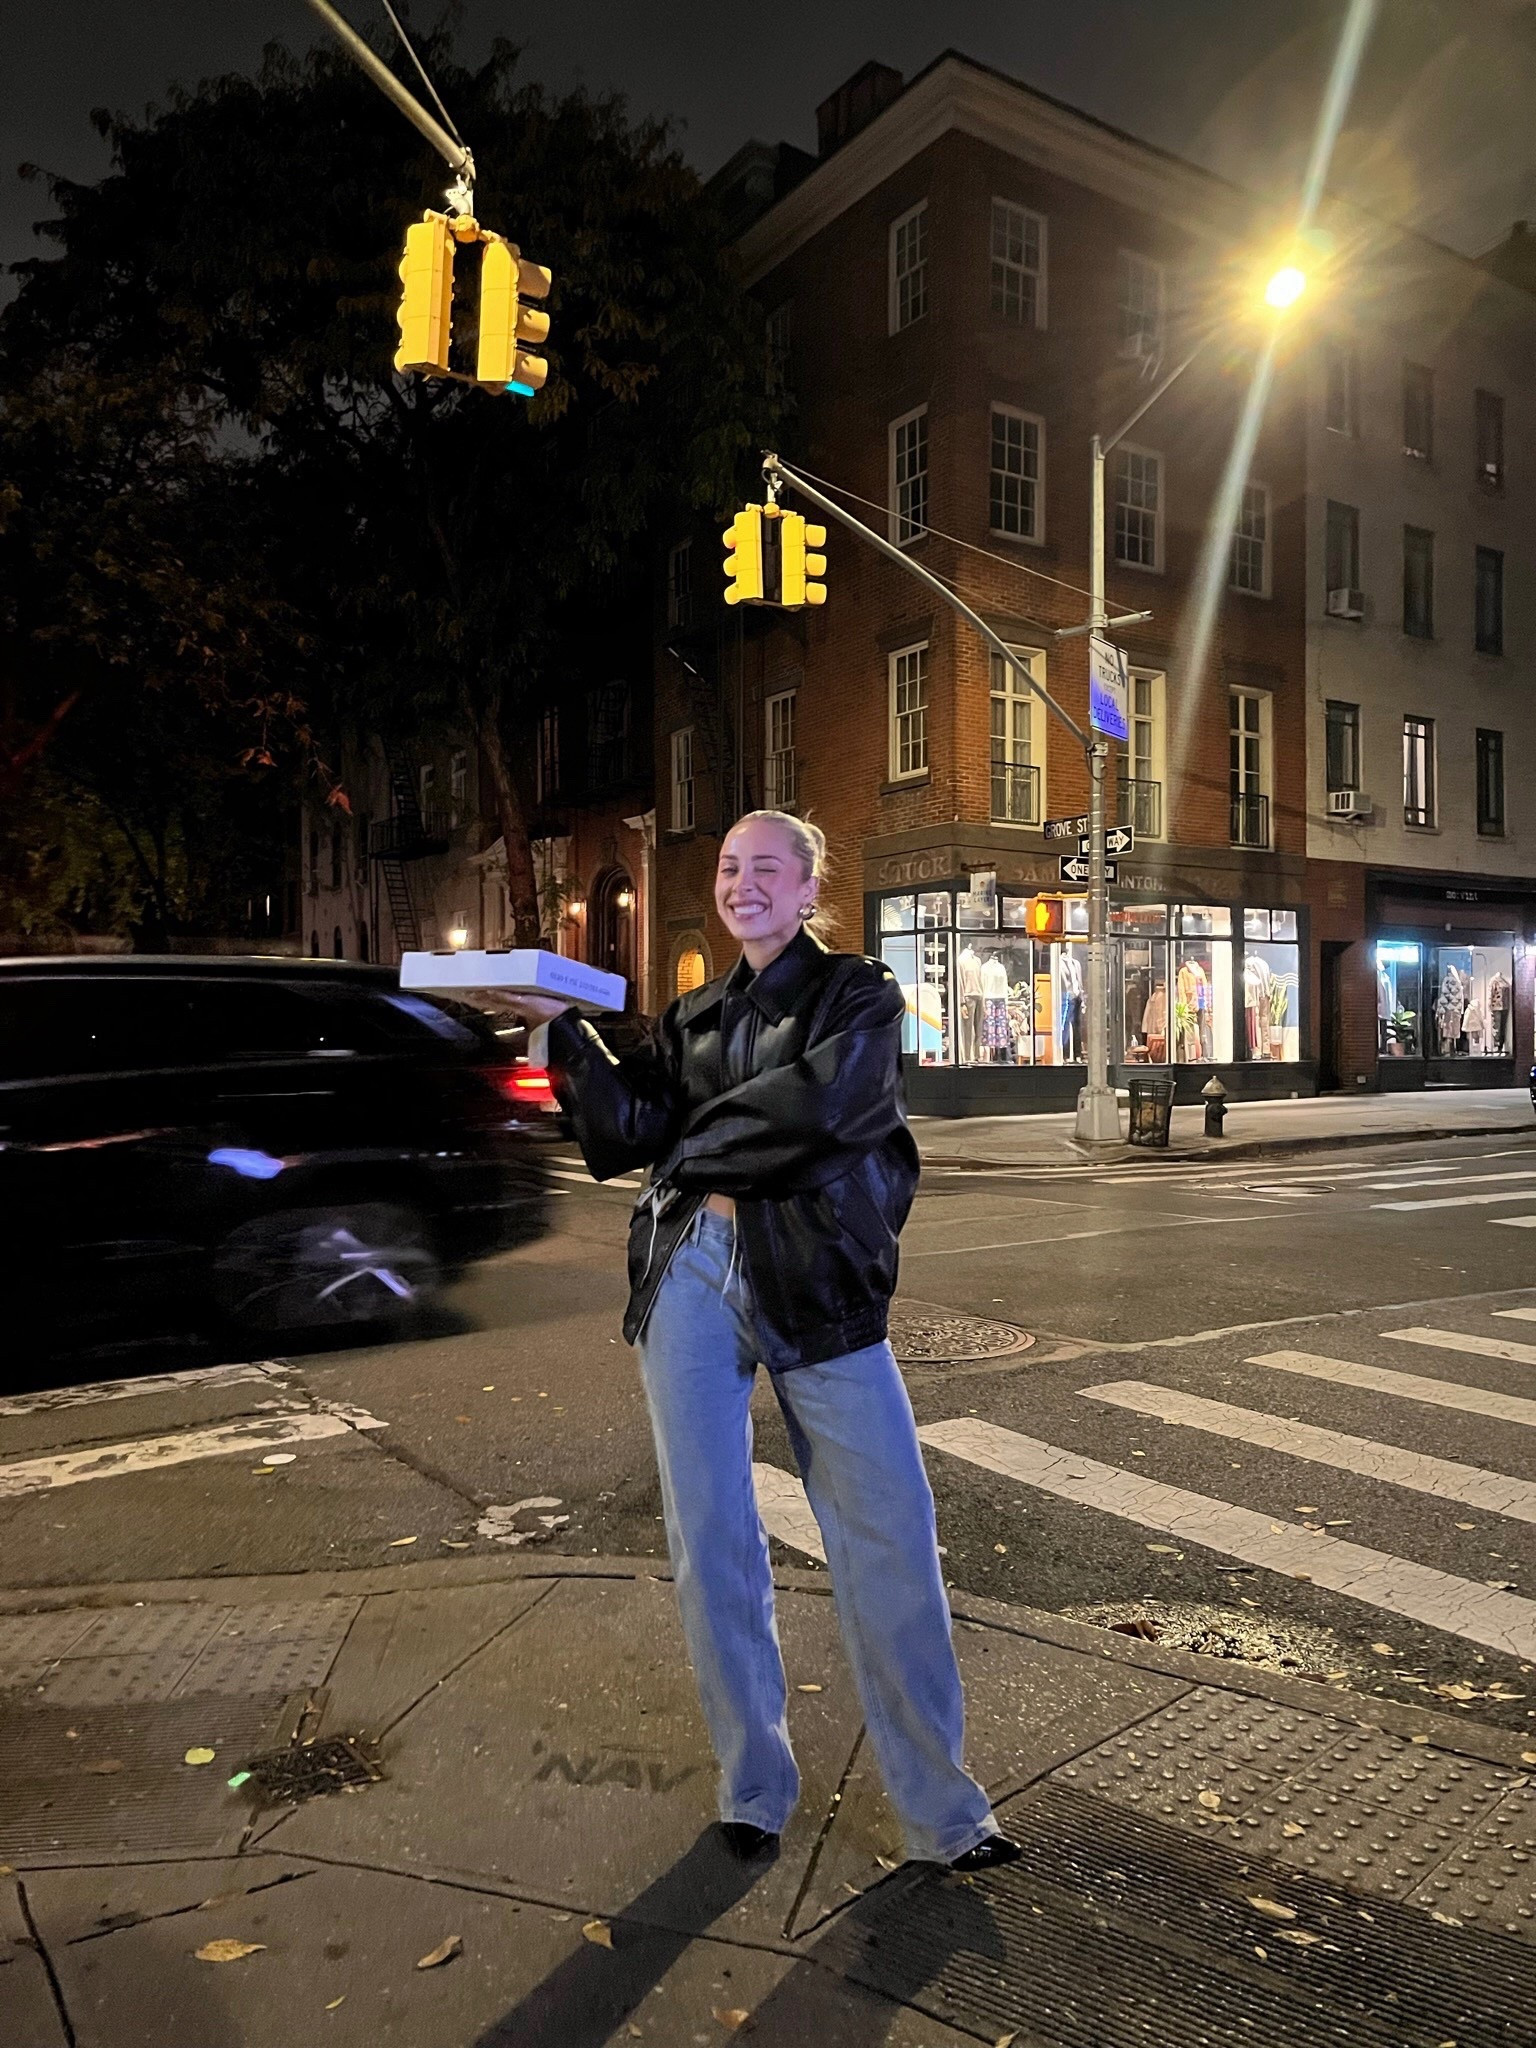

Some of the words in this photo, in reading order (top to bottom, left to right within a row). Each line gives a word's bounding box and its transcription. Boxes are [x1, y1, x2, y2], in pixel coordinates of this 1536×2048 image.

[1104, 652, 1114, 667] NO
[1098, 665, 1120, 685] TRUCKS
[1101, 692, 1119, 711] LOCAL
[1045, 820, 1072, 838] GROVE
[1077, 817, 1088, 833] ST
[1108, 835, 1124, 847] WAY
[1071, 864, 1088, 875] ONE
